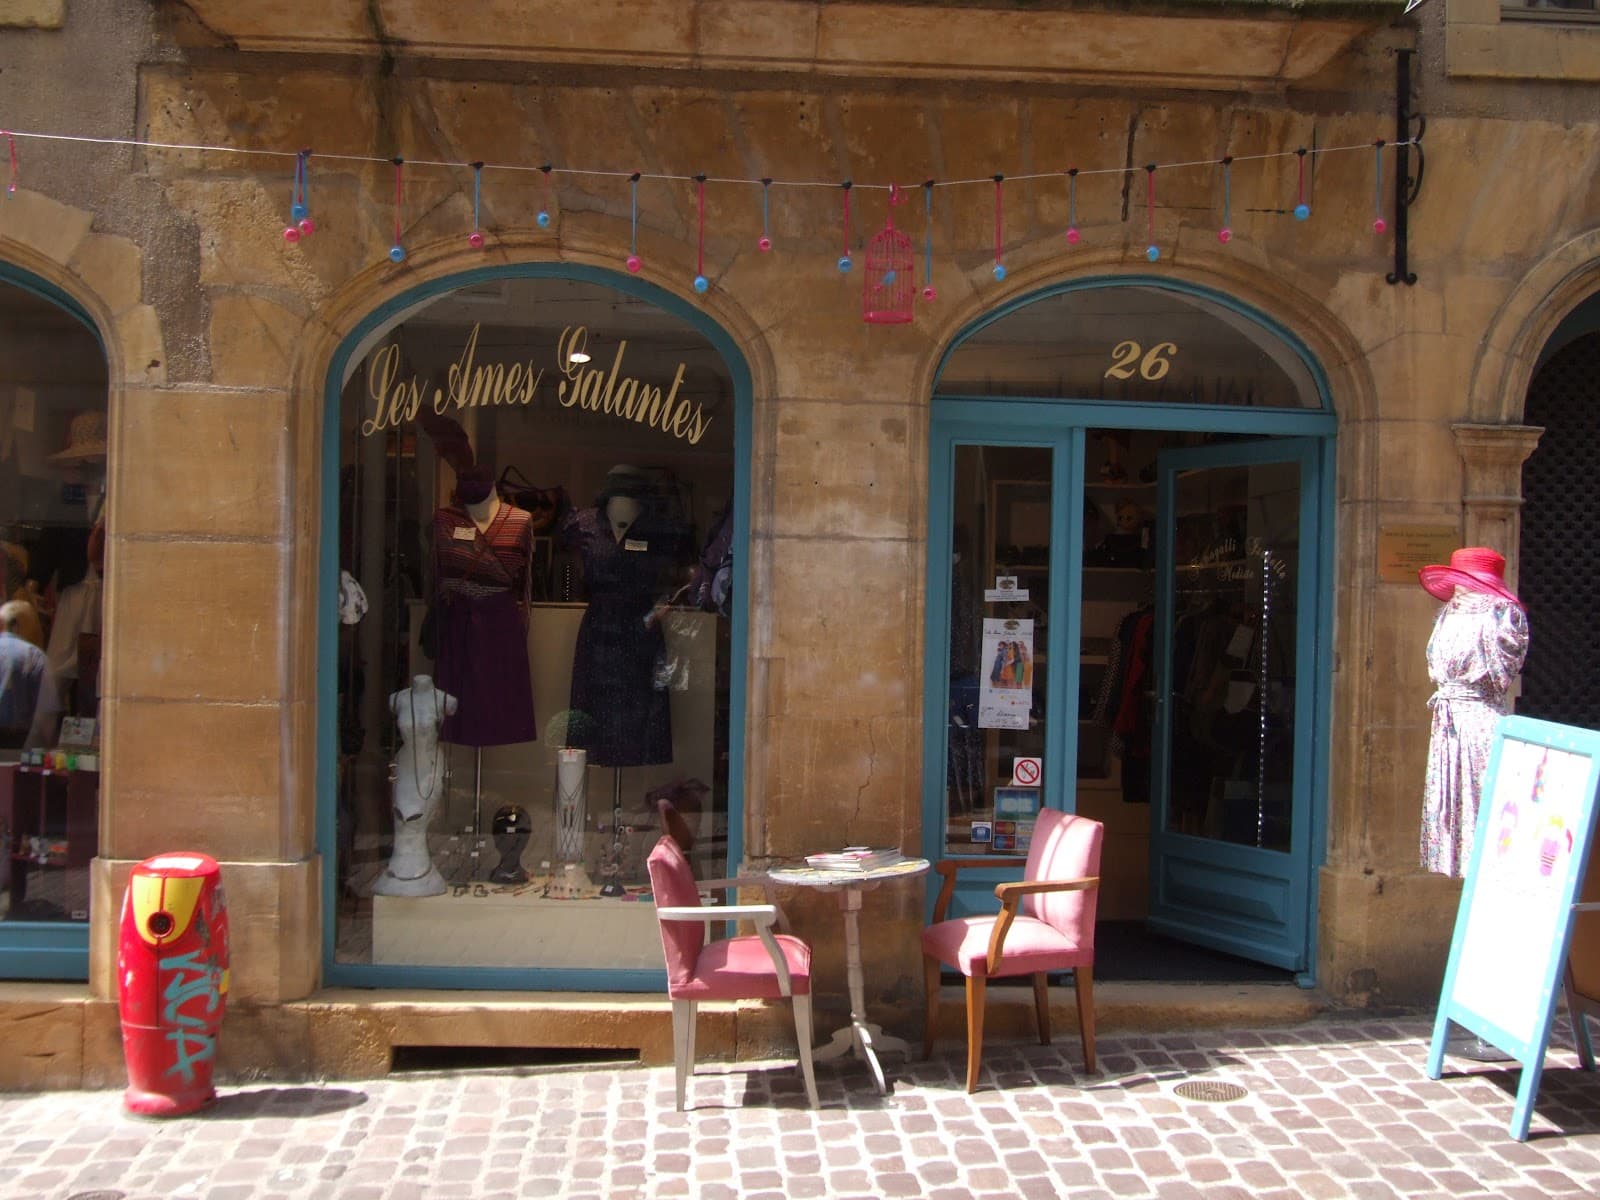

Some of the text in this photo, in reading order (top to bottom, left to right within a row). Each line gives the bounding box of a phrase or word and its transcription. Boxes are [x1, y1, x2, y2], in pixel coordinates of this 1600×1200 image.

[362, 322, 713, 446] Les Ames Galantes
[1103, 339, 1178, 381] 26
